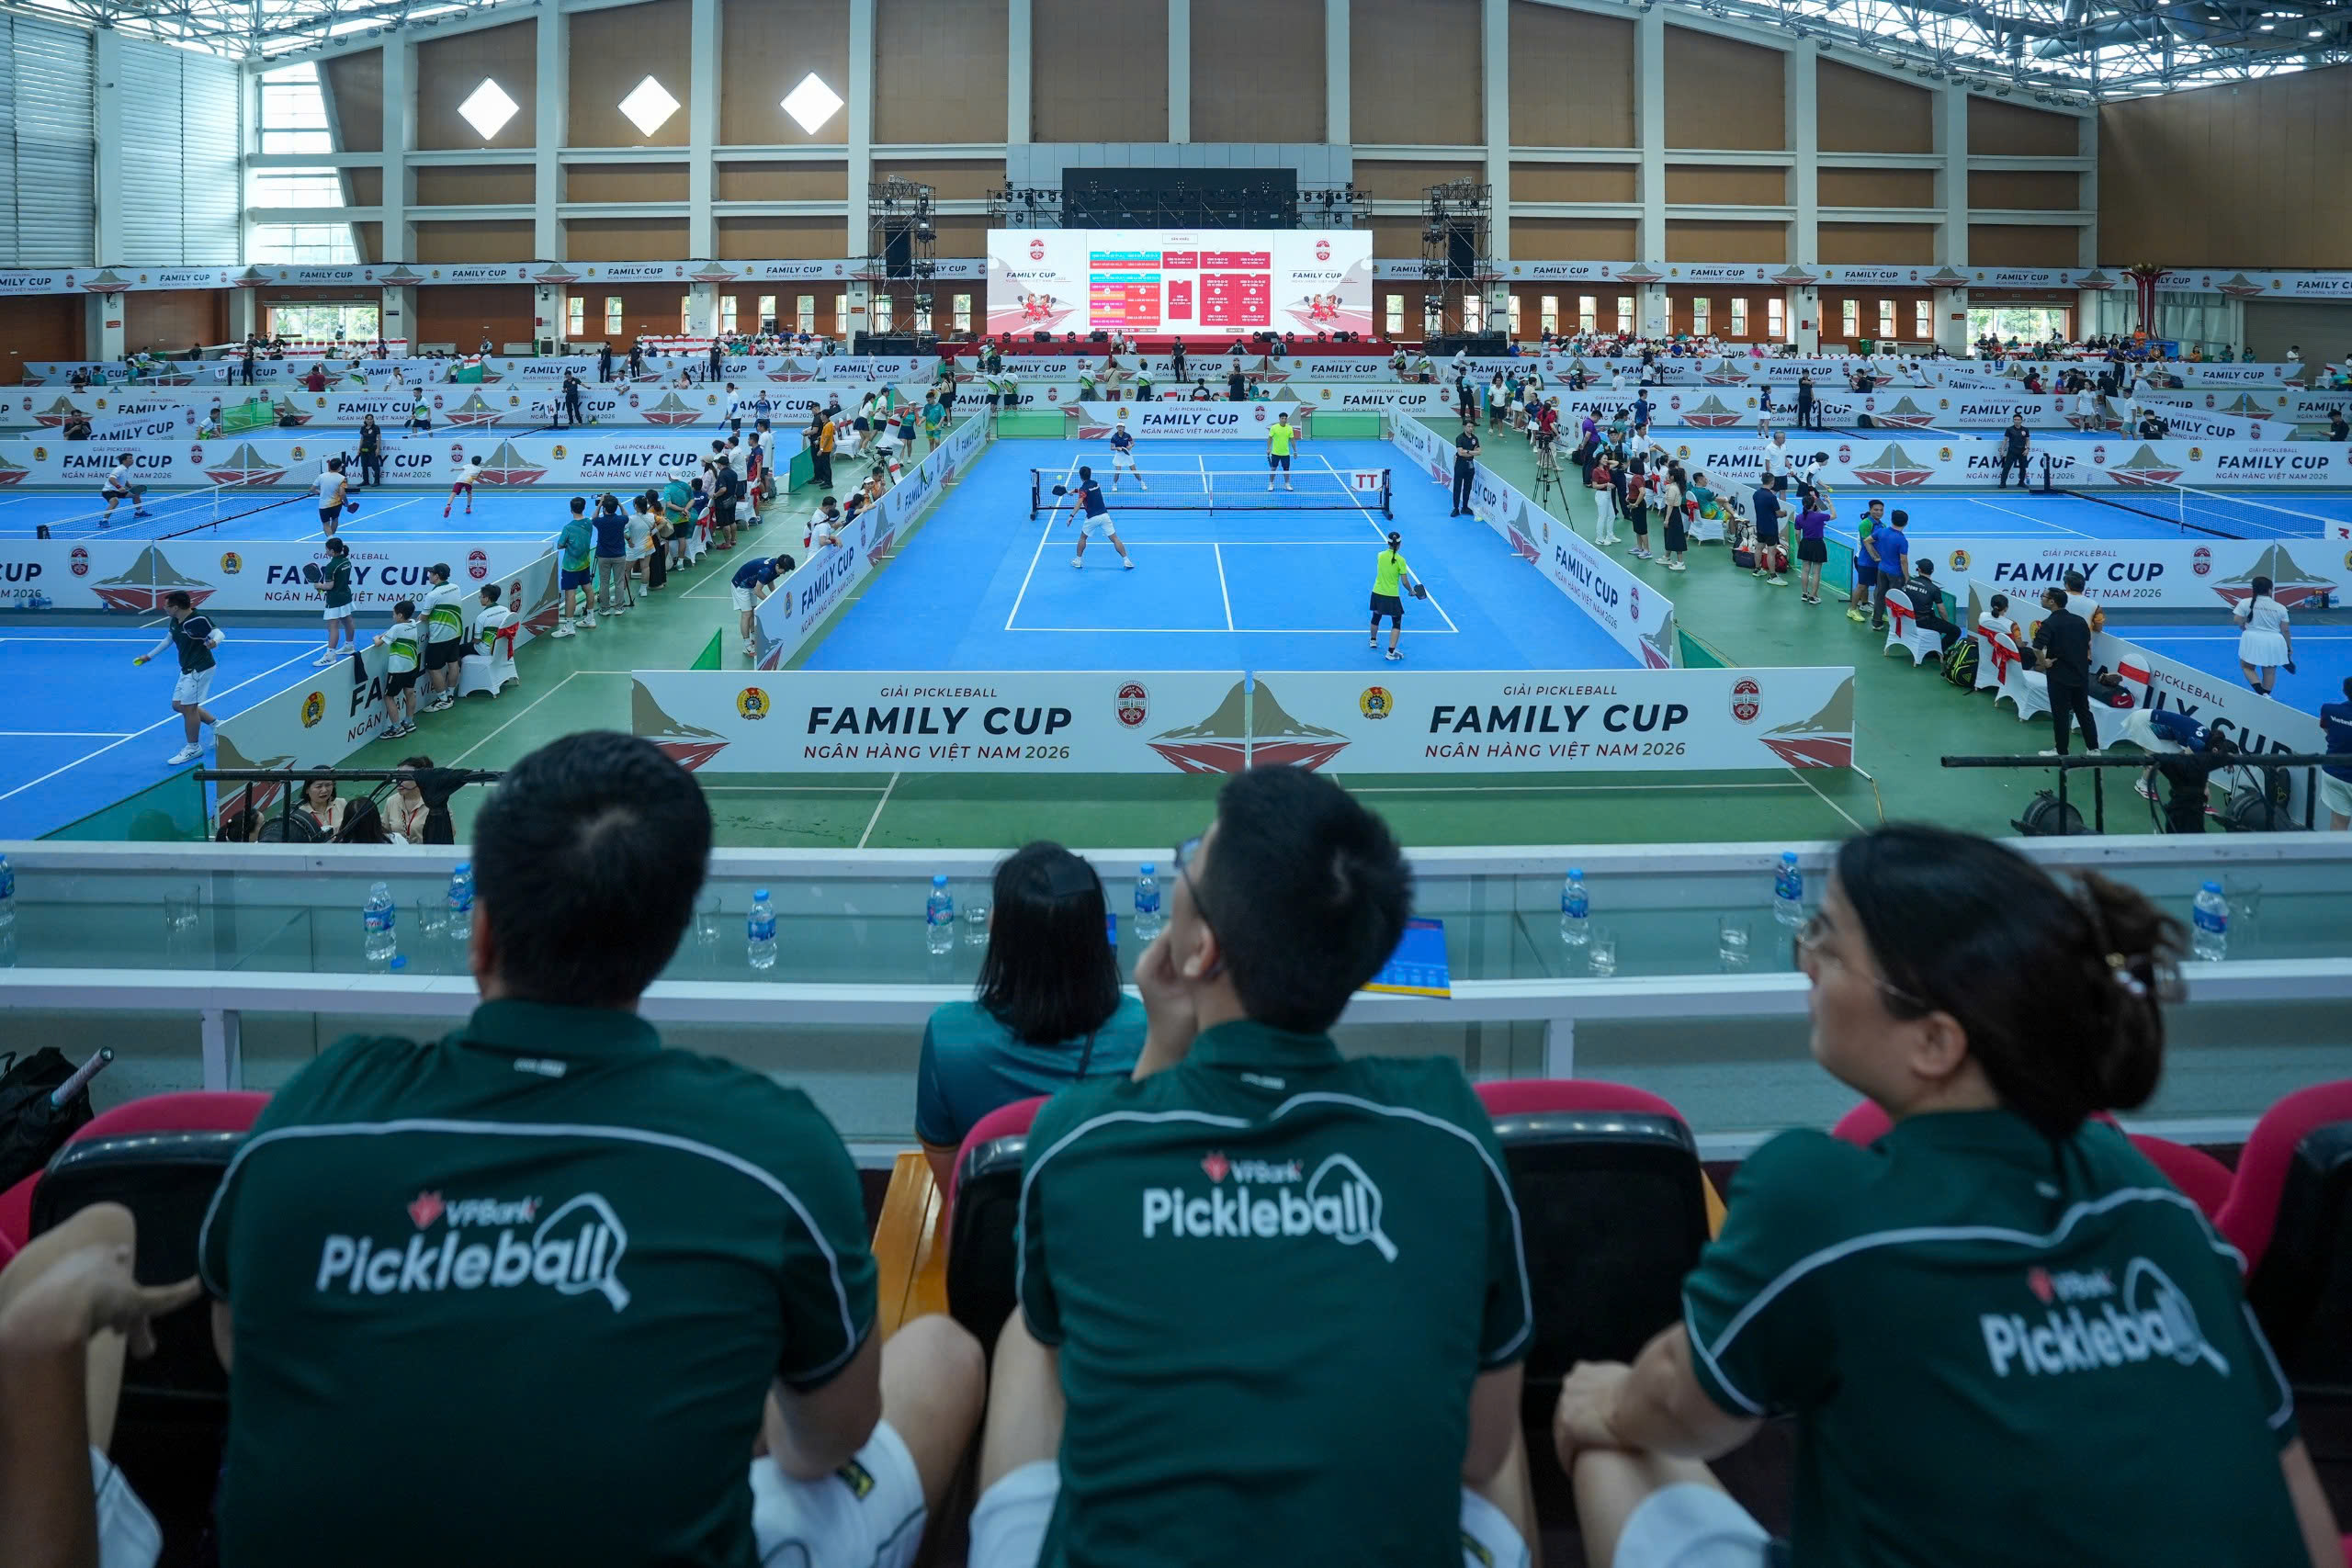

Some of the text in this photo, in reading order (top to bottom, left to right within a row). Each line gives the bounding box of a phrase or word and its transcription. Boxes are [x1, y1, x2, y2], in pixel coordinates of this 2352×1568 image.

[2297, 281, 2338, 289] FAMILY
[1355, 365, 1377, 373] CUP
[588, 401, 616, 411] CUP
[1399, 395, 1426, 405] CUP
[2298, 402, 2345, 411] FAMILY
[338, 403, 389, 412] FAMILY
[1961, 406, 2010, 414] FAMILY
[1143, 414, 1238, 424] FAMILY CUP
[147, 422, 174, 434] CUP
[2206, 425, 2235, 438] CUP
[1400, 425, 1424, 450] FAMILY CUP
[63, 456, 172, 468] FAMIL CUP
[395, 455, 432, 467] CUP
[582, 454, 697, 467] FAMILY CUP
[1707, 455, 1764, 467] FAMIL
[2218, 457, 2329, 468] FAMILY CUP
[1356, 474, 1378, 488] TT
[1483, 485, 1497, 507] CUP
[0, 563, 42, 581] UP
[1555, 545, 1619, 608] FAMILY CUP
[2107, 563, 2165, 581] CUP
[801, 547, 854, 615] FAMILY CUP
[14, 589, 42, 597] 2026
[265, 591, 300, 602] NGÂN
[378, 592, 407, 602] NAM
[2102, 590, 2162, 598] NAM 2026
[1605, 613, 1618, 629] 2026
[880, 683, 998, 698] GIẢI PICKLEBALL
[1503, 683, 1618, 695] GIẢI PICKLEBALL
[2154, 670, 2225, 707] PICKLEBALL
[807, 707, 1072, 735] FAMILY CUP
[1430, 705, 1689, 733] FAMILY CUP
[347, 712, 382, 742] NGÂN
[804, 742, 1070, 762] NGÂN HÀNG VIỆT NAM 2026
[1425, 740, 1686, 760] NGÂN HÀNG VIỆT NAM 2026
[447, 1197, 542, 1227] VPBank
[1143, 1180, 1370, 1238] Pickleball
[317, 1223, 609, 1293] Pickleball
